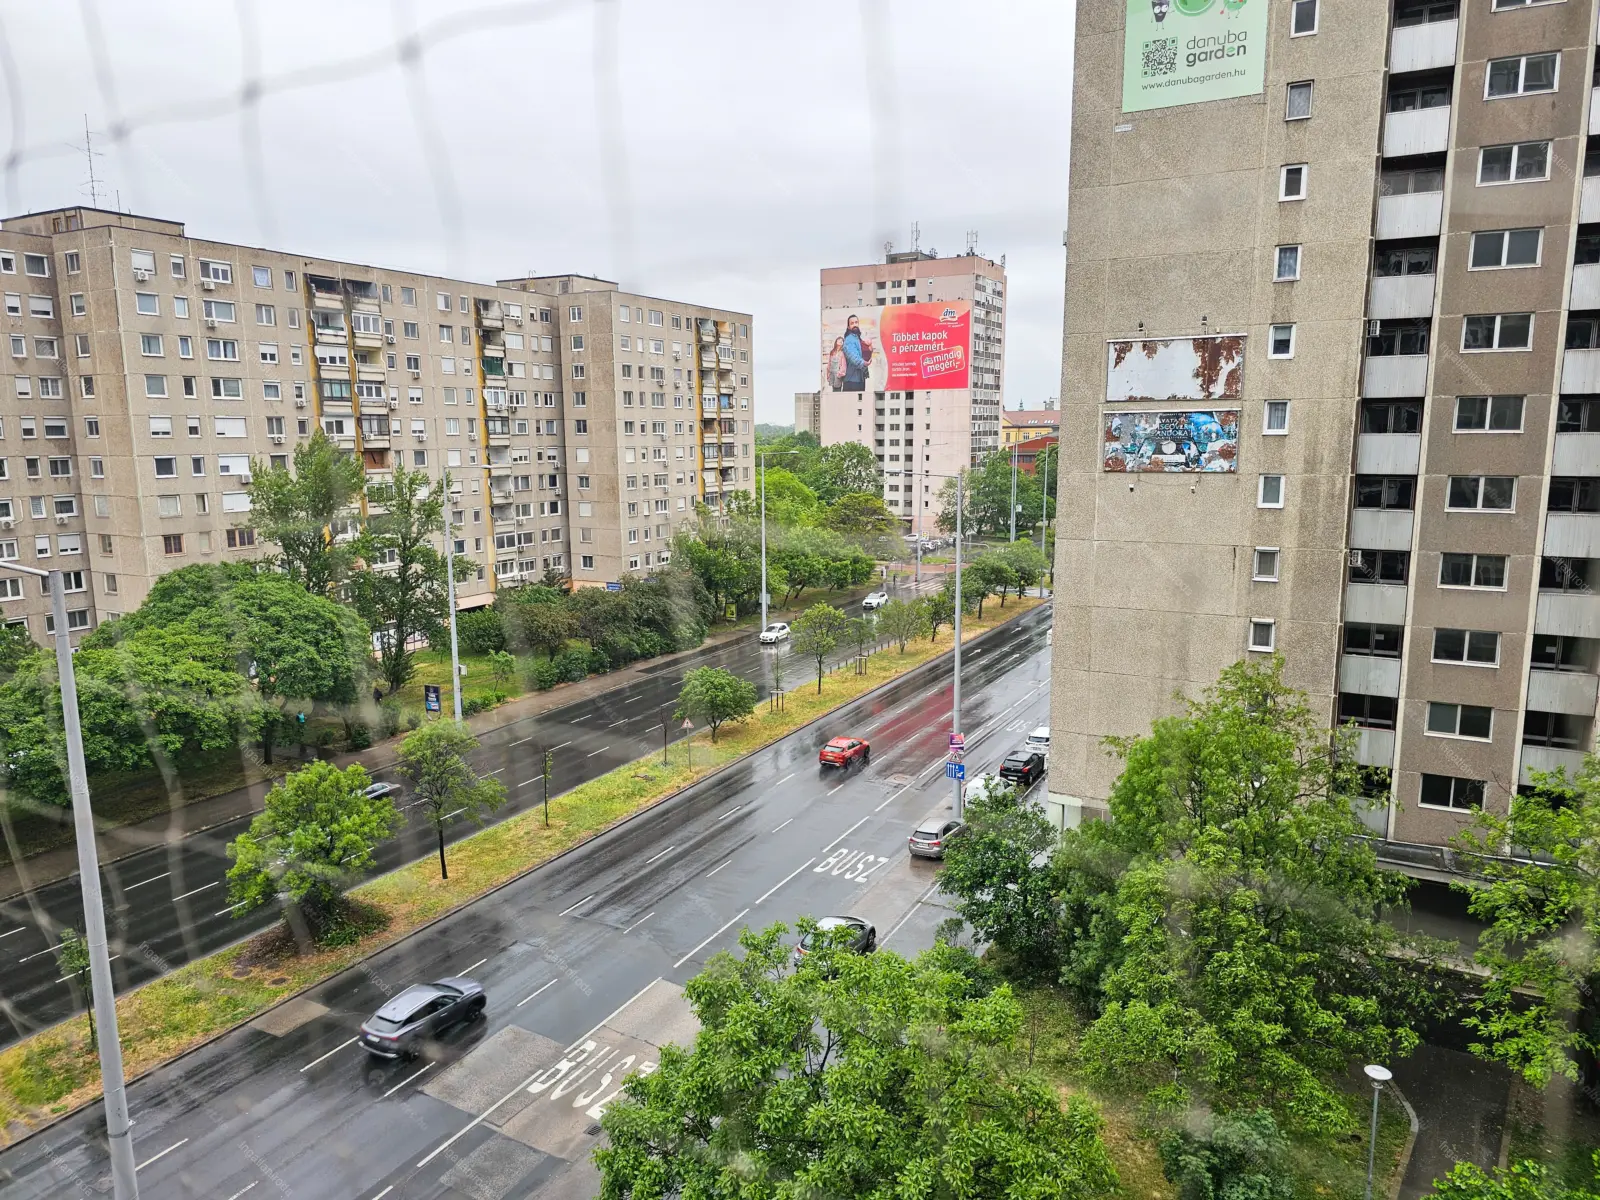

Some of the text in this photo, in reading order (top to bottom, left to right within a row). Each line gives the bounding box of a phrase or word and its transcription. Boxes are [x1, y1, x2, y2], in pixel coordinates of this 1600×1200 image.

[1186, 30, 1248, 50] danuba
[1186, 44, 1247, 67] garden
[1141, 68, 1246, 91] www.danubagarden.hu
[892, 330, 948, 342] Többet kapok
[892, 345, 897, 353] a
[934, 350, 962, 362] mindig
[812, 848, 890, 883] BUSZ
